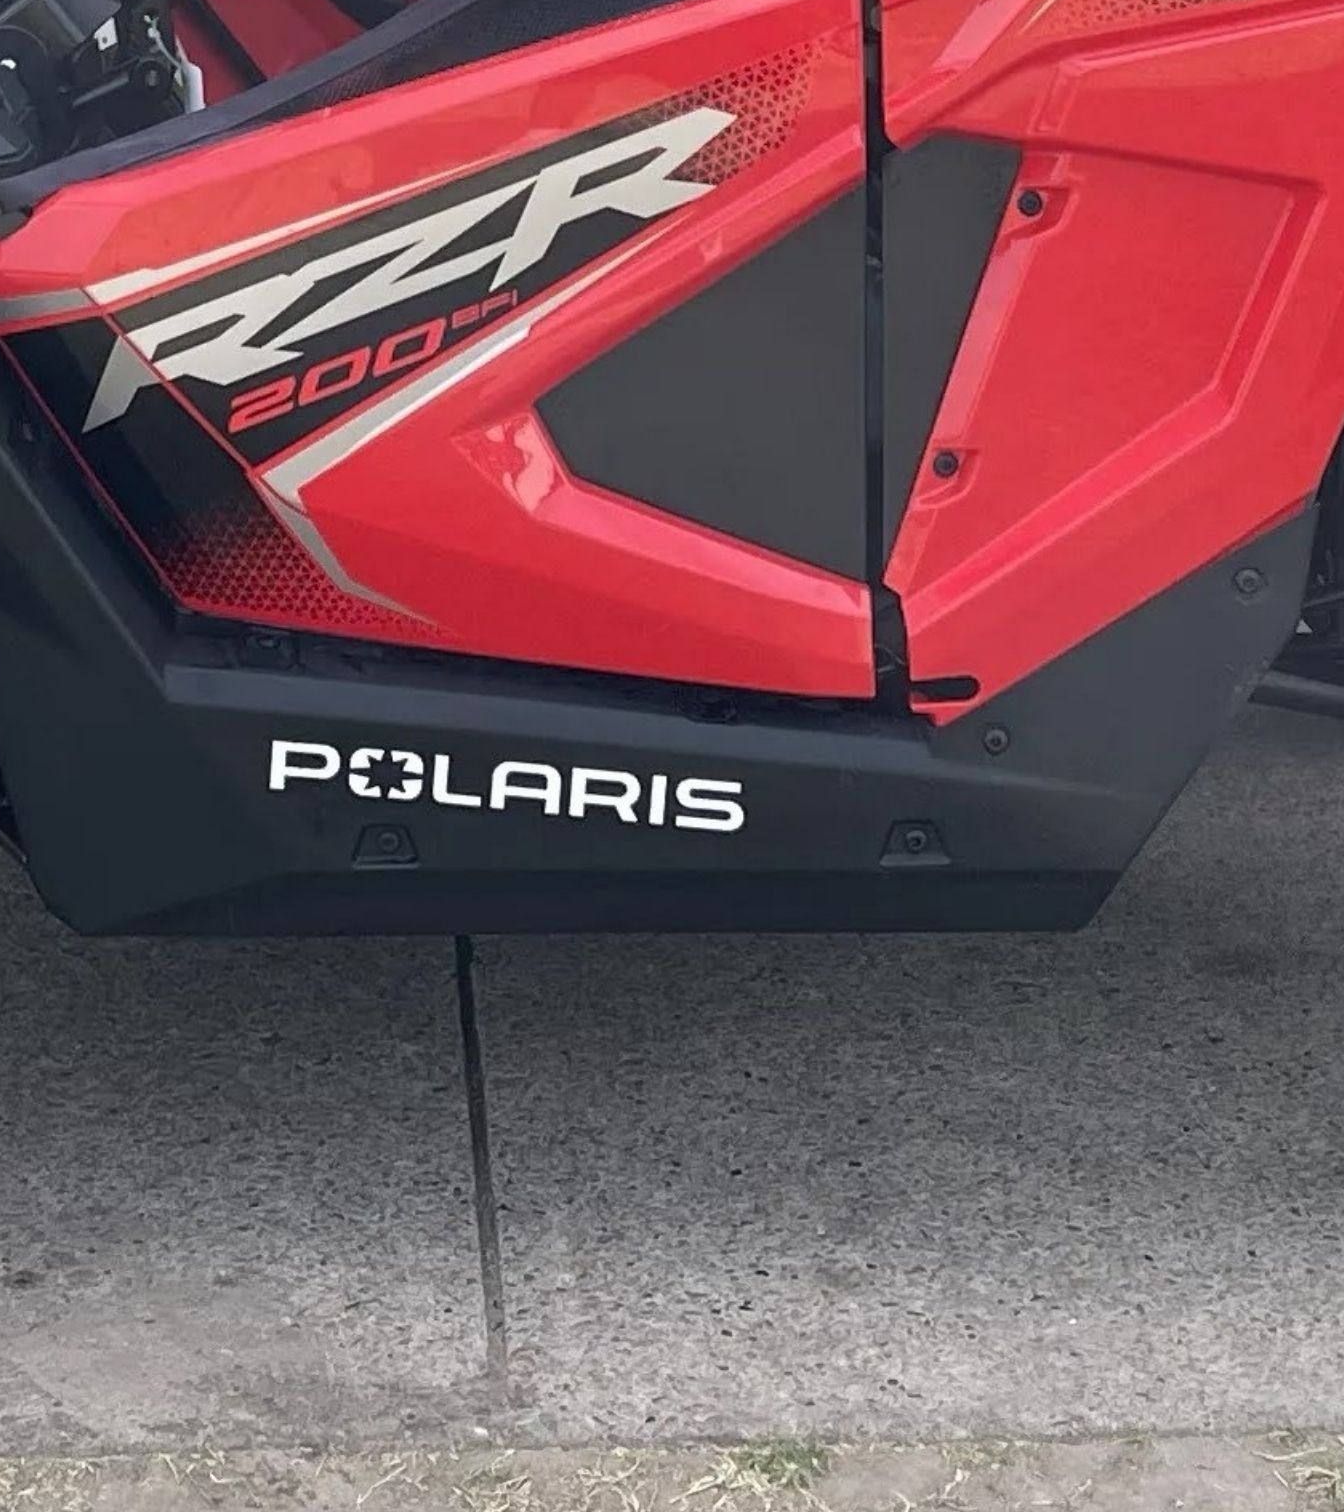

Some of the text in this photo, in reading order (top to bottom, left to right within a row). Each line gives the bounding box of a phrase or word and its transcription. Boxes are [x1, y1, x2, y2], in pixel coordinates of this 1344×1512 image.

[81, 106, 737, 433] RZR
[228, 317, 447, 433] 200
[268, 739, 746, 833] POLARIS
